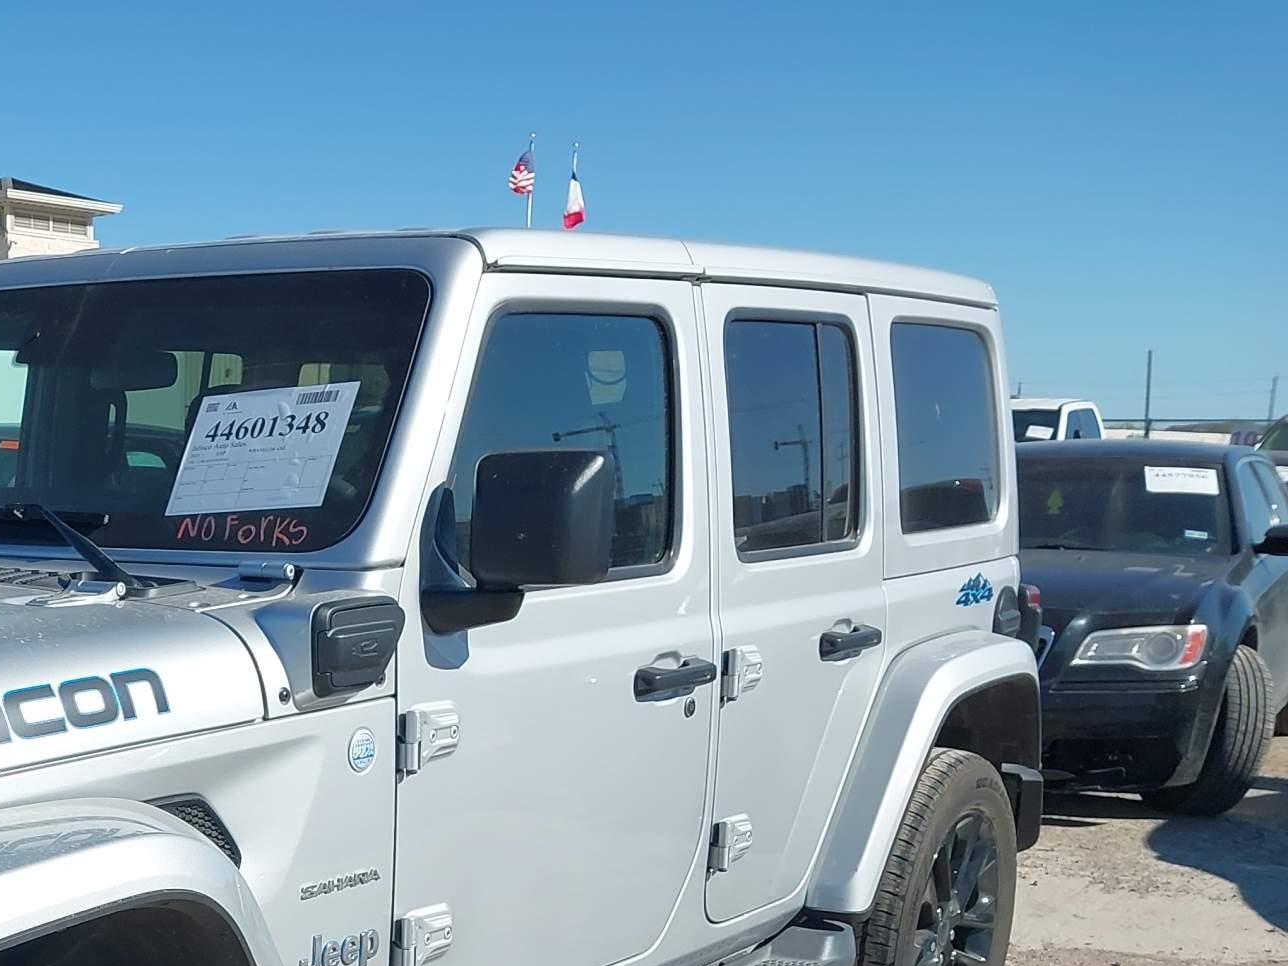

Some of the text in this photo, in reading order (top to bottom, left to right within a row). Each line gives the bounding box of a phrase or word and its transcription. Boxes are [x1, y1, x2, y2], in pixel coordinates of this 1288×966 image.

[204, 411, 330, 443] 44601348
[177, 513, 215, 542] NO
[300, 869, 381, 901] SAHARA
